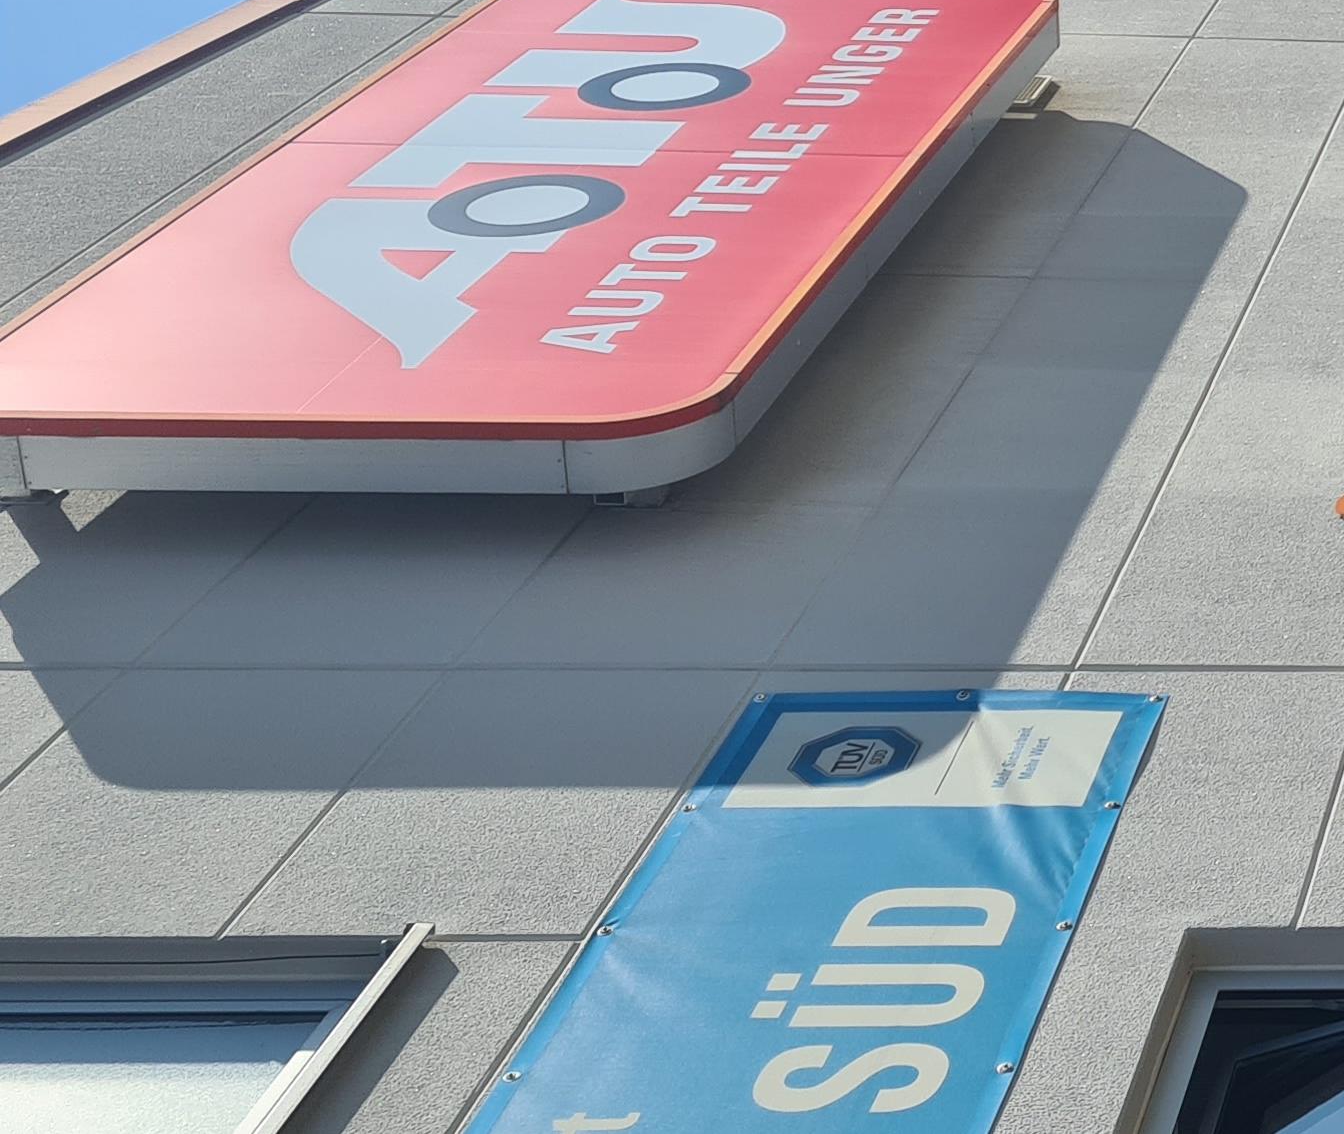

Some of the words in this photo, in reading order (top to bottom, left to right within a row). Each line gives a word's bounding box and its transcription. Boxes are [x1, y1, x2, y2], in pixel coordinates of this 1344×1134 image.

[539, 236, 717, 354] AUTO
[668, 123, 829, 217] TEILE
[783, 9, 940, 107] UNGER
[830, 742, 869, 772] TÜV
[1017, 759, 1040, 779] Mehr
[990, 769, 1011, 788] Mehr
[750, 887, 1017, 1113] SÜD
